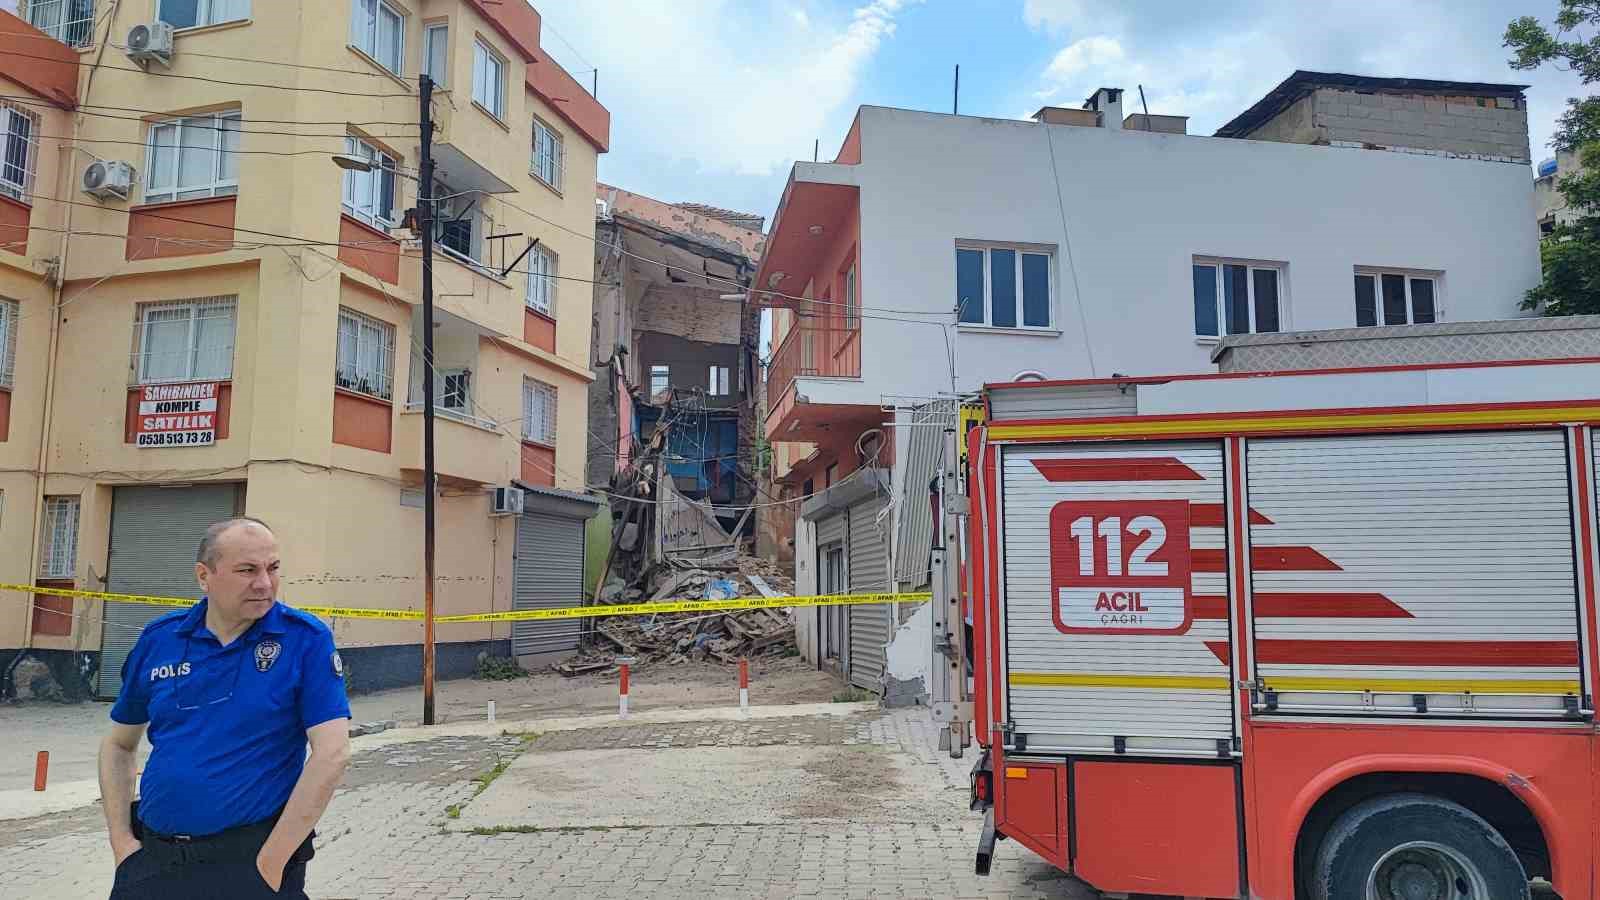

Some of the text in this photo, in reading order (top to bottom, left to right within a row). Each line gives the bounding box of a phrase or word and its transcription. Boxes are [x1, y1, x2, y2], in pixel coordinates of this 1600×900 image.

[155, 401, 201, 413] KOMPLE
[143, 415, 212, 430] SATILIK
[139, 431, 212, 445] 0538 513 73 28
[1070, 515, 1169, 577] 112
